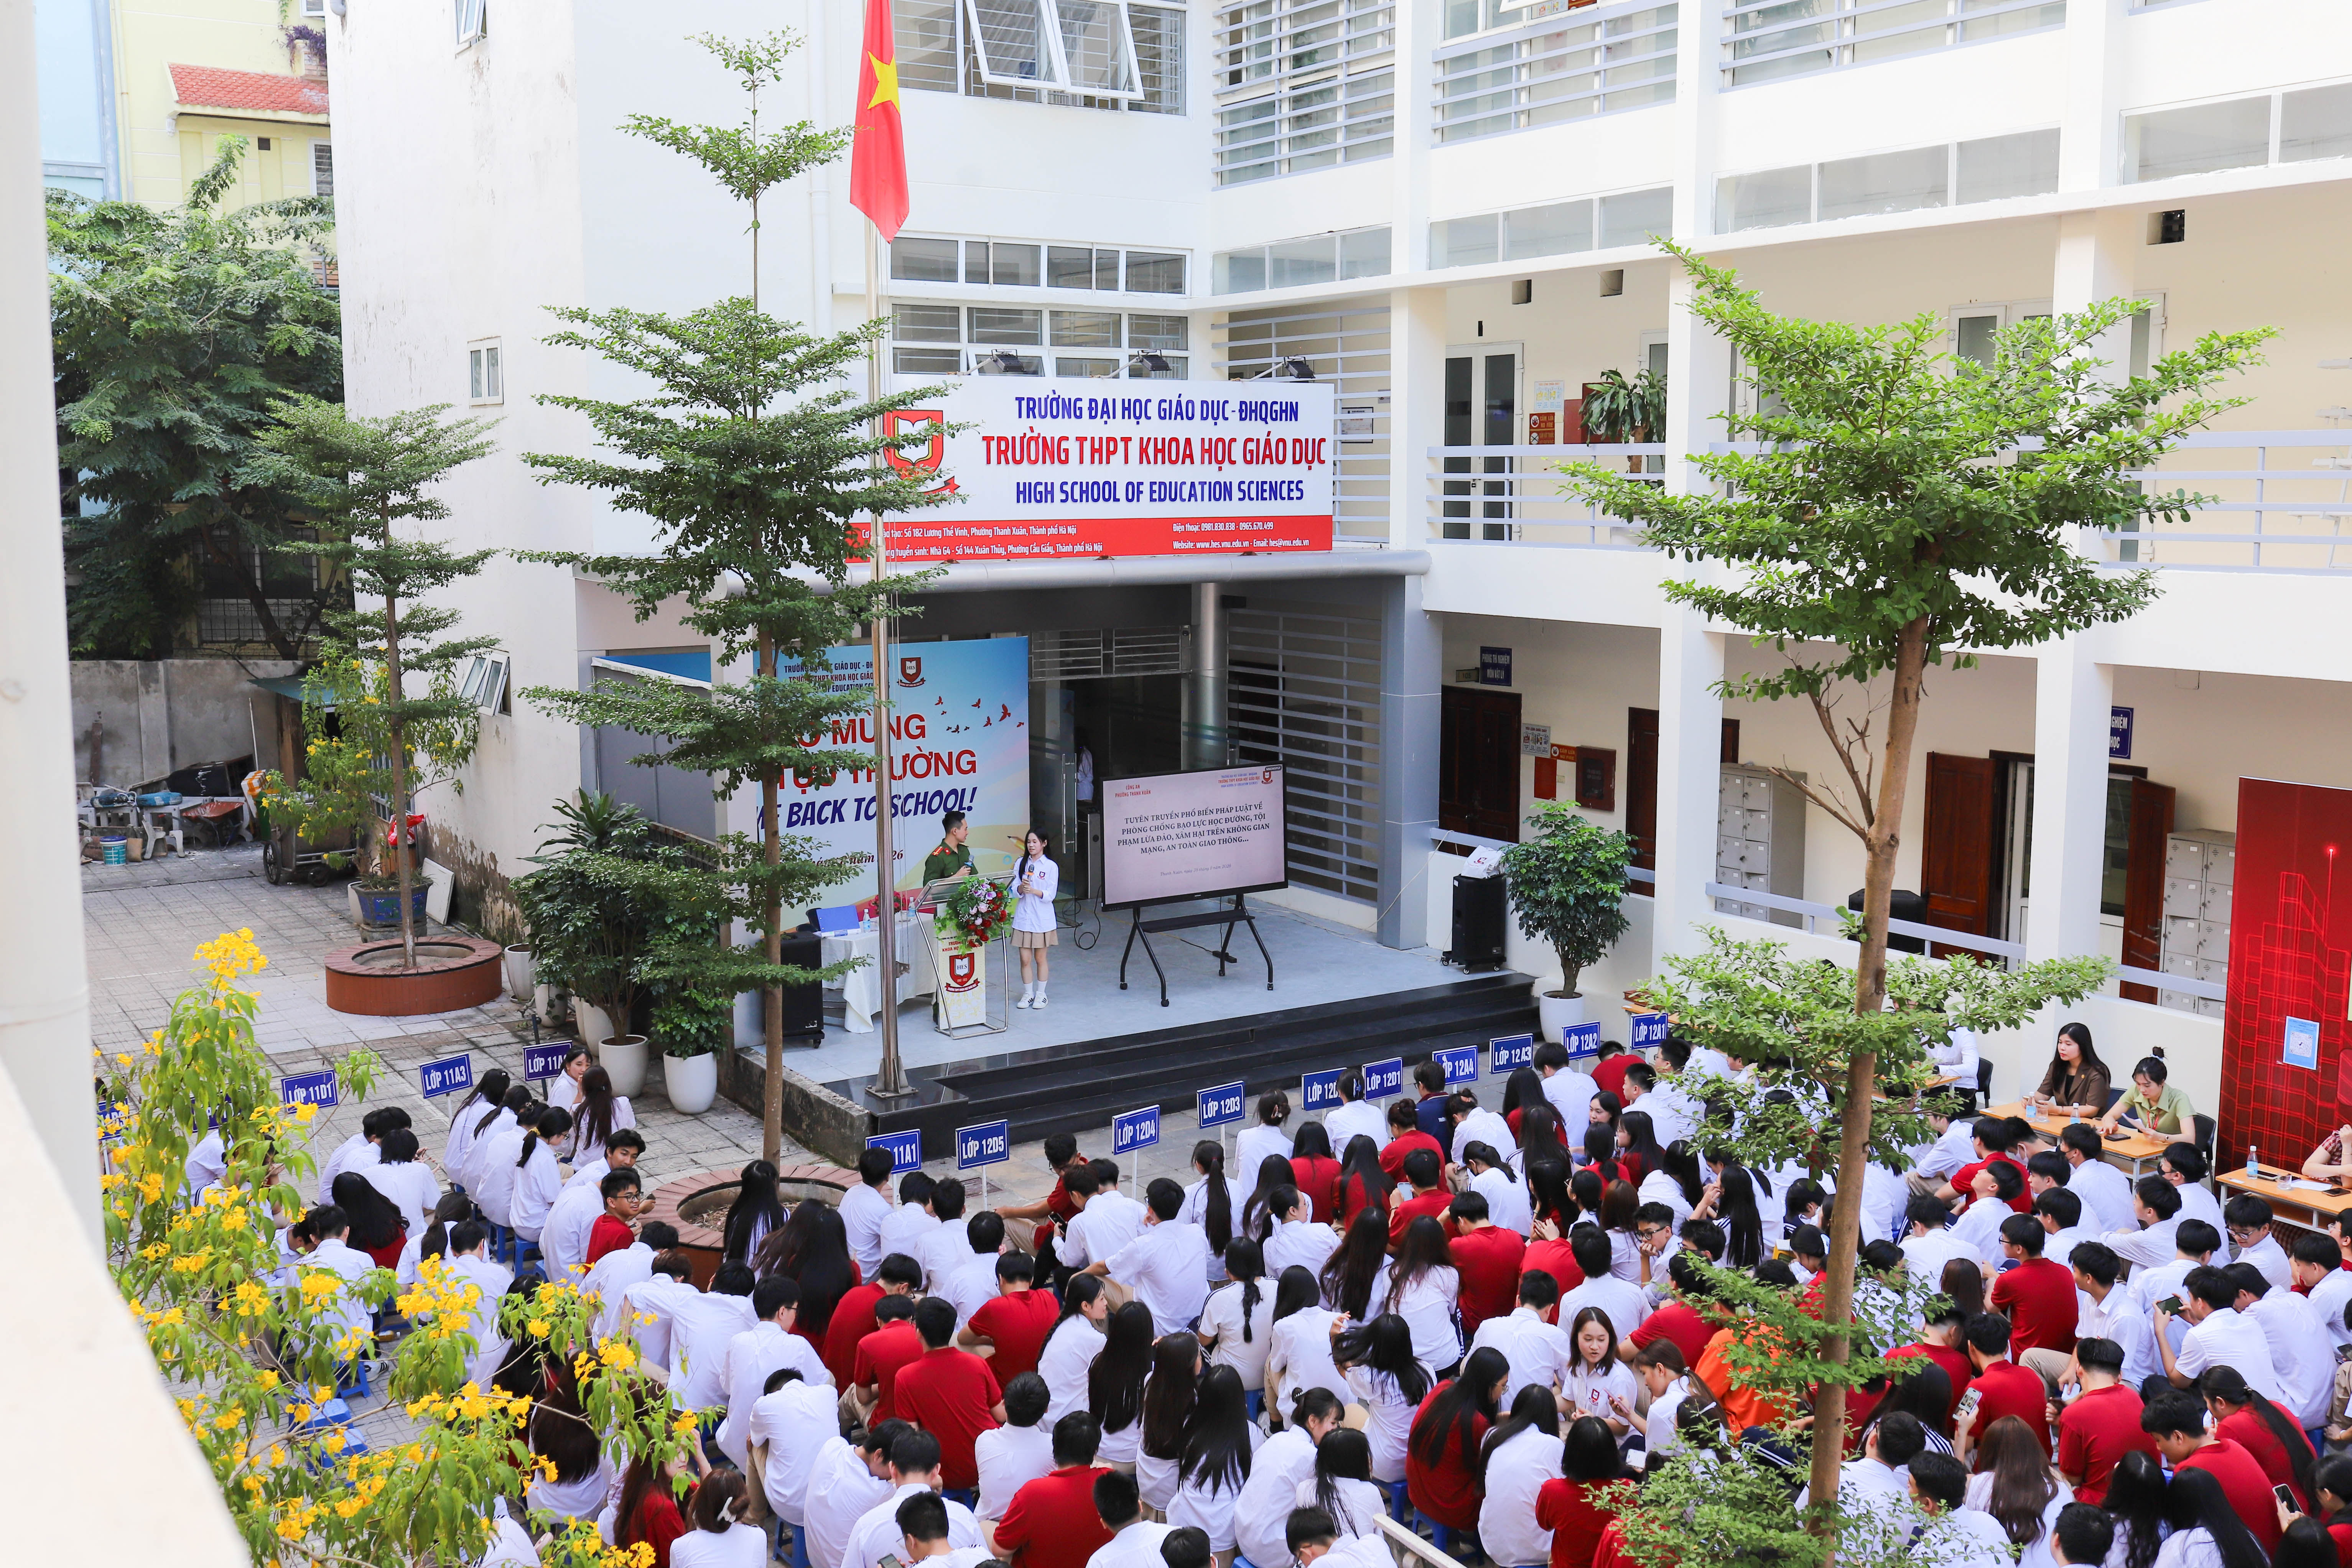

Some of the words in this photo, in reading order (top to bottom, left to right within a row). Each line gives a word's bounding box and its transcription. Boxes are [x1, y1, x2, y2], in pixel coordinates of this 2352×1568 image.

[1015, 390, 1082, 419] TRƯỜNG
[1088, 398, 1116, 424] ĐẠI
[1122, 399, 1151, 424] HỌC
[1158, 394, 1195, 420] GIÁO
[1200, 400, 1229, 426] DỤC
[1239, 401, 1299, 424] ĐHQGHN
[982, 426, 1069, 465] TRƯỜNG
[1076, 437, 1132, 464] THPT
[1139, 437, 1194, 464] KHOA
[1201, 438, 1237, 471] HỌC
[1243, 431, 1287, 465] GIÁO
[1292, 438, 1326, 471] DỤC
[1016, 482, 1054, 503] HIGH
[1060, 481, 1120, 503] SCHOOL
[1126, 482, 1144, 502] OF
[1149, 481, 1232, 502] EDUCATION
[1238, 480, 1304, 501] SCIENCES
[904, 526, 912, 537] Số
[913, 529, 923, 537] 182
[924, 528, 942, 538] Lương
[943, 525, 953, 537] Thế
[971, 525, 992, 538] Phường
[993, 527, 1011, 536] Thanh
[1012, 526, 1028, 536] Xuân,
[1029, 525, 1046, 535] Thành
[1048, 524, 1058, 536] phố
[1059, 526, 1066, 534] Hà
[1068, 525, 1076, 536] Nội
[1173, 523, 1185, 533] Điện
[1185, 522, 1200, 533] thoại:
[1201, 522, 1235, 531] 0981.830.838
[1239, 522, 1274, 530] 0965.670.499
[896, 545, 913, 558] tuyển
[914, 546, 929, 556] sinh:
[930, 546, 941, 555] Nhà
[943, 547, 951, 555] G4
[956, 544, 963, 554] Số
[964, 546, 973, 554] 144
[975, 545, 989, 554] Xuân
[1008, 543, 1029, 555] Phường
[1030, 542, 1040, 553] Cầu
[1056, 543, 1073, 553] Thành
[1074, 541, 1084, 553] phố
[1085, 543, 1092, 551] Hà
[1093, 542, 1103, 553] Nội
[1173, 540, 1195, 549] Website:
[1196, 539, 1249, 548] www.hes.vnu.edu.vn
[1253, 539, 1268, 547] Email:
[1269, 538, 1309, 547] hes@vnu.edu.vn
[784, 663, 807, 673] TRƯỜN
[834, 661, 848, 671] GIÁO
[850, 662, 861, 671] DỤC
[830, 674, 845, 682] KHOA
[848, 673, 859, 683] HỌC
[2111, 714, 2128, 731] GHIỆM
[786, 798, 848, 828] BACK
[854, 795, 877, 822] TO
[891, 786, 978, 818] SCHOOL!
[1124, 815, 1149, 824] TUYÊN
[1181, 808, 1196, 818] PHỔ
[1198, 807, 1214, 816] BIẾN
[1216, 806, 1234, 814] PHÁP
[1235, 804, 1253, 813] LUẬT
[1122, 826, 1147, 835] PHÒNG
[1150, 822, 1175, 832] CHỐNG
[1177, 821, 1191, 830] BẠO
[1193, 819, 1206, 828] LỰC
[1208, 818, 1223, 826] HỌC
[1225, 815, 1252, 824] ĐƯỜNG,
[1254, 812, 1266, 821] TỘI
[1118, 838, 1139, 847] PHẠM
[1141, 835, 1155, 844] LỪA
[1157, 833, 1174, 842] ĐẢO,
[1175, 831, 1191, 839] XÂM
[1193, 830, 1205, 839] HẠI
[1206, 827, 1225, 836] TRÊN
[1226, 825, 1251, 834] KHÔNG
[1141, 846, 1165, 855] MẠNG,
[1178, 841, 1197, 849] TOÀN
[1635, 1022, 1648, 1042] LỚP
[1649, 1023, 1665, 1040] 12A1
[1567, 1033, 1578, 1053] LỚP
[1580, 1033, 1597, 1051] 12A2
[528, 1054, 545, 1073] LỚP
[547, 1054, 566, 1071] 11A
[1495, 1046, 1509, 1066] LỚP
[1511, 1046, 1532, 1063] 12A3
[425, 1069, 441, 1090] LỚP
[444, 1065, 466, 1086] 11A3
[1455, 1058, 1474, 1077] 12A4
[1367, 1073, 1381, 1091] LỚP
[1383, 1070, 1401, 1088] 12D1
[288, 1085, 306, 1104] LỚP
[309, 1083, 332, 1101] 11D1
[1308, 1081, 1322, 1103] LỚP
[1324, 1080, 1339, 1100] 12D
[1203, 1098, 1218, 1119] LỚP
[1220, 1096, 1240, 1115] 12D3
[1118, 1123, 1133, 1147] LỚP
[1136, 1119, 1155, 1141] 12D4
[893, 1143, 916, 1165] 11A1
[962, 1137, 979, 1159] LỚP
[982, 1136, 1004, 1155] 12D5
